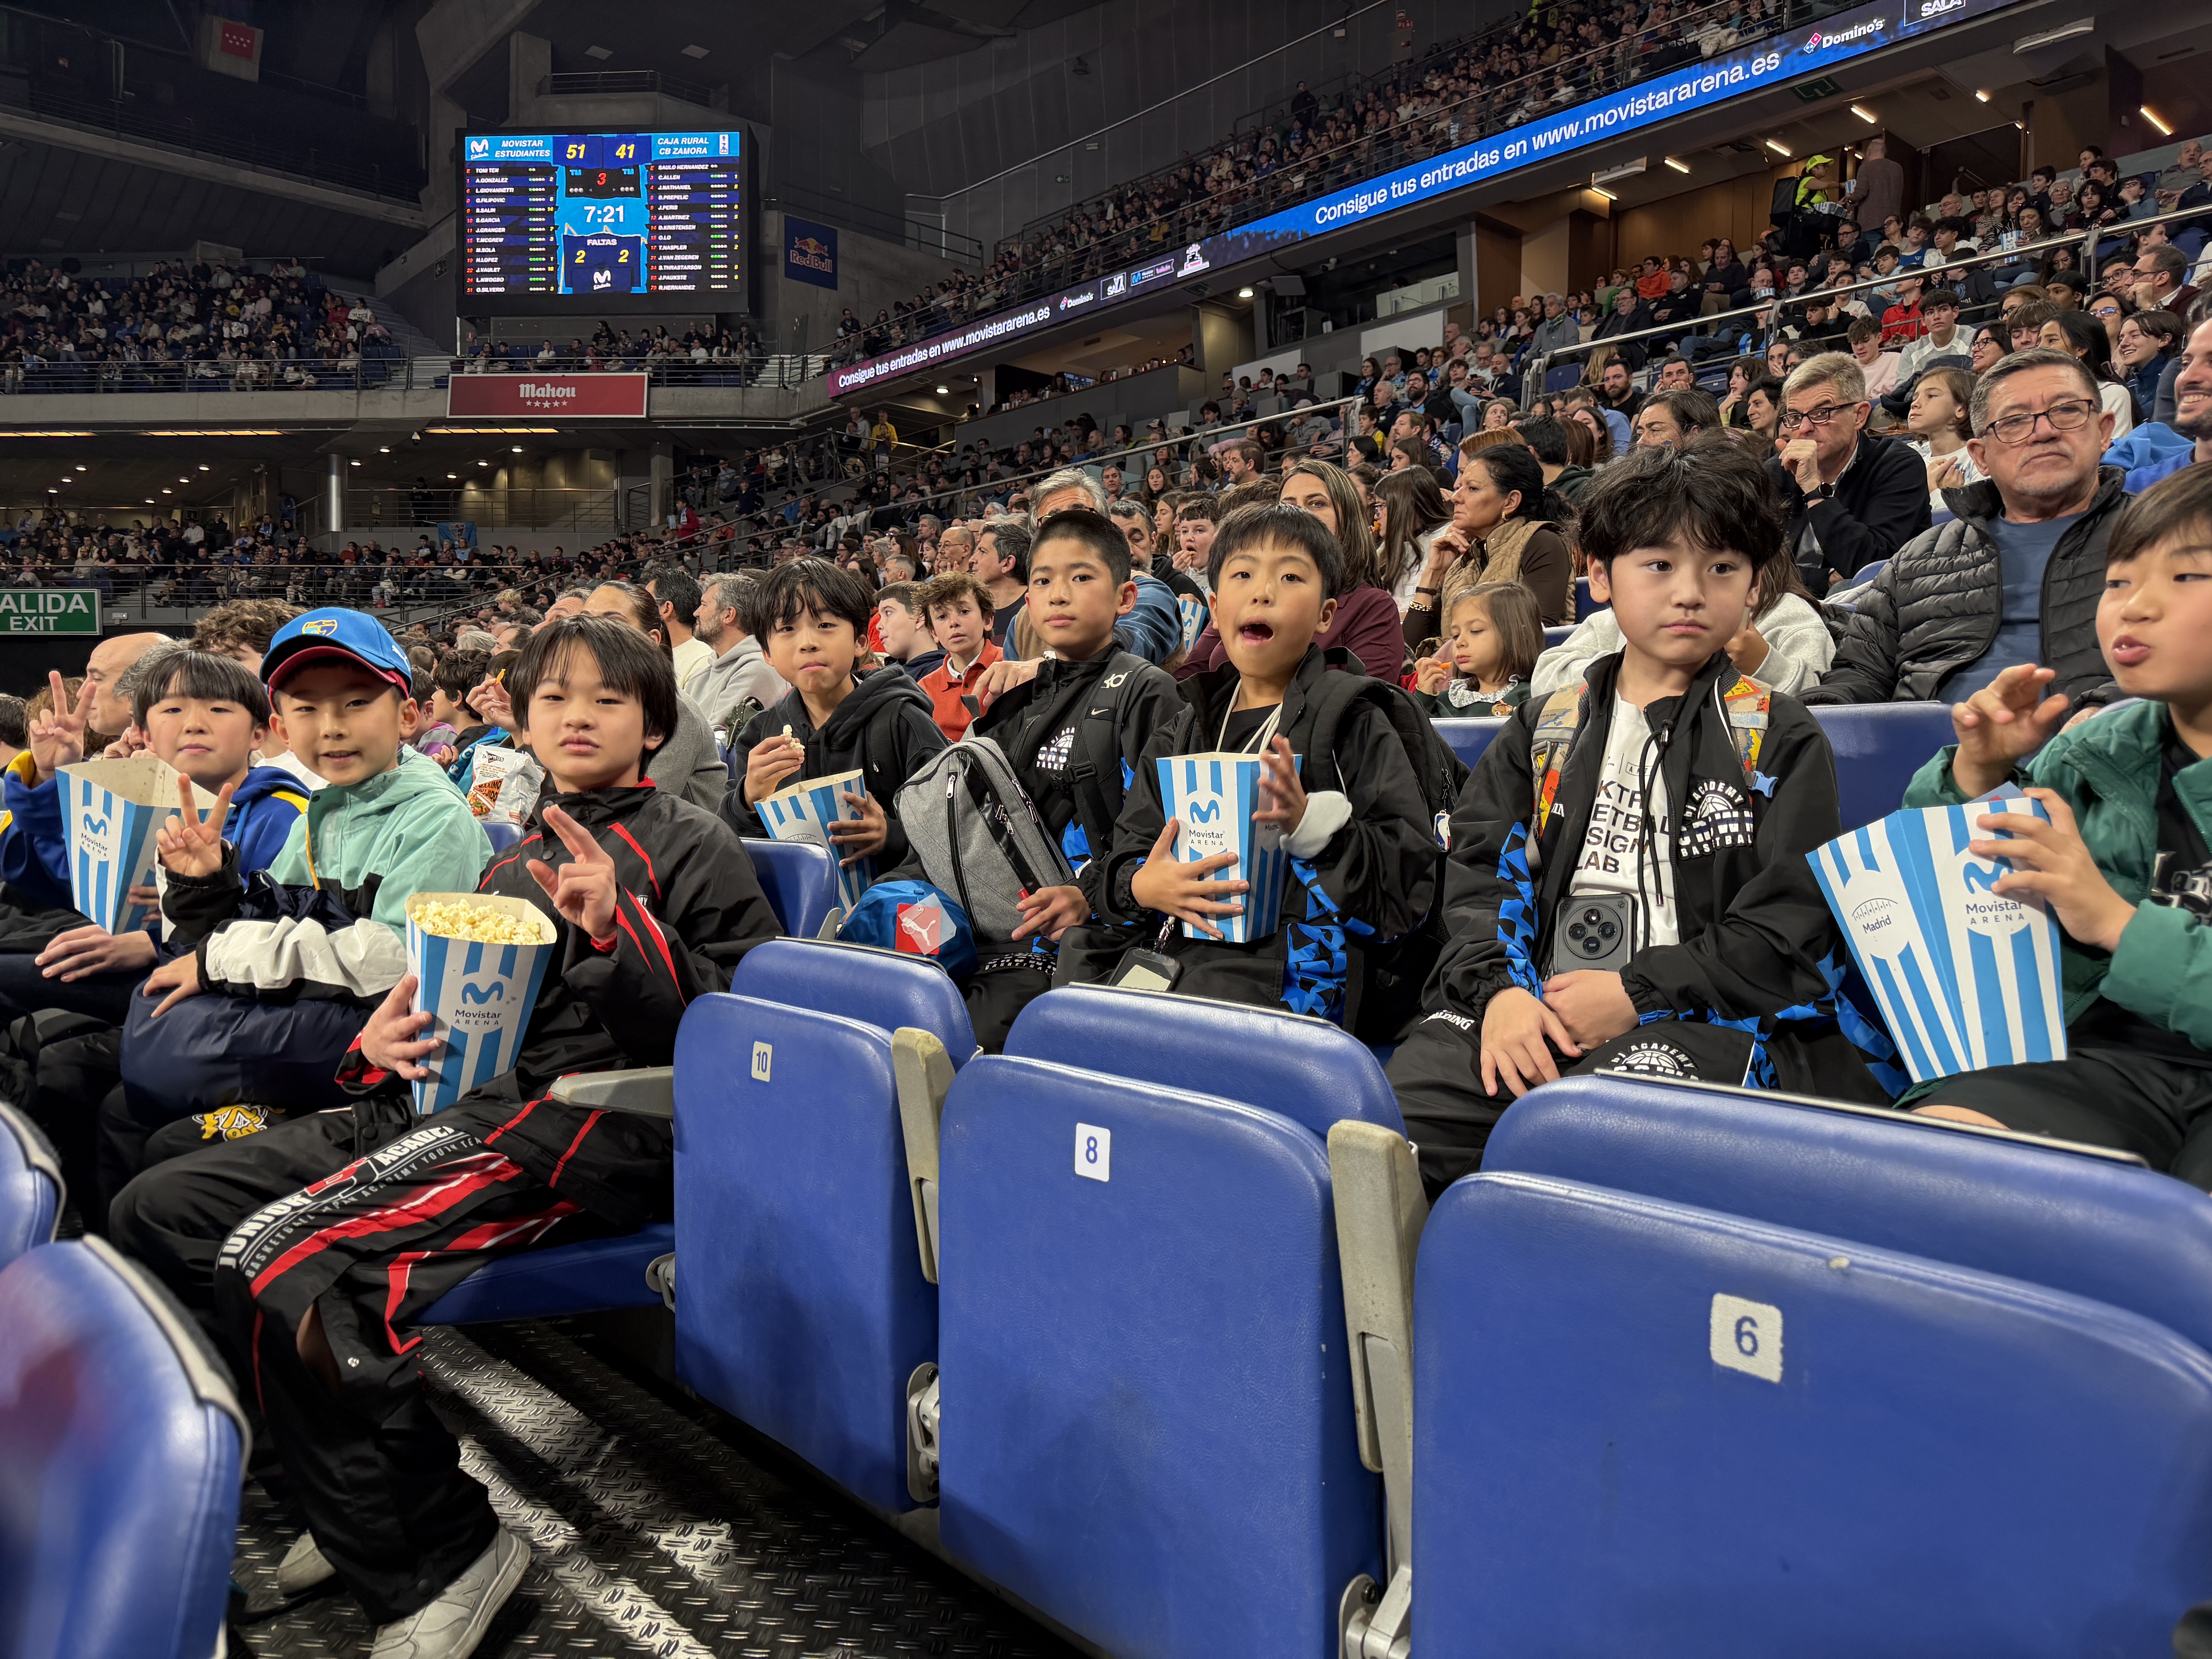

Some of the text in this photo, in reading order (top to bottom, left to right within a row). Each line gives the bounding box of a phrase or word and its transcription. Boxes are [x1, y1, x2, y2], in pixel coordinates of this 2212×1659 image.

[1822, 18, 1884, 48] Domino's
[1316, 53, 1779, 225] Consigue tus entradas en www.movistararena.es
[566, 144, 586, 159] 51
[615, 144, 635, 159] 41
[597, 172, 607, 186] 3
[584, 205, 624, 223] 7:21
[575, 250, 586, 263] 2
[618, 249, 629, 263] 2
[790, 250, 832, 273] Red Bull
[1067, 292, 1094, 308] Domino's
[839, 306, 1051, 388] Consigue tus entradas en www.movistararena.es
[519, 383, 576, 398] Mahou
[0, 594, 89, 613] ALIDA
[10, 616, 58, 631] EXIT
[1036, 761, 1065, 771] BASKE
[81, 833, 108, 851] Movistar
[1189, 829, 1223, 839] Movistar
[82, 841, 106, 857] ARENA
[1966, 901, 2024, 914] Movistar
[1862, 915, 1892, 934] Madrid
[1970, 913, 2025, 925] ARENA
[455, 1009, 502, 1018] Movistar
[1419, 1012, 1475, 1030] ALDING
[756, 1050, 768, 1073] 10
[1630, 1043, 1695, 1068] ACADEMY
[460, 1137, 482, 1148] TEA
[1085, 1135, 1098, 1164] 8
[219, 1194, 313, 1270] JUNIOR
[1735, 1315, 1759, 1357] 6
